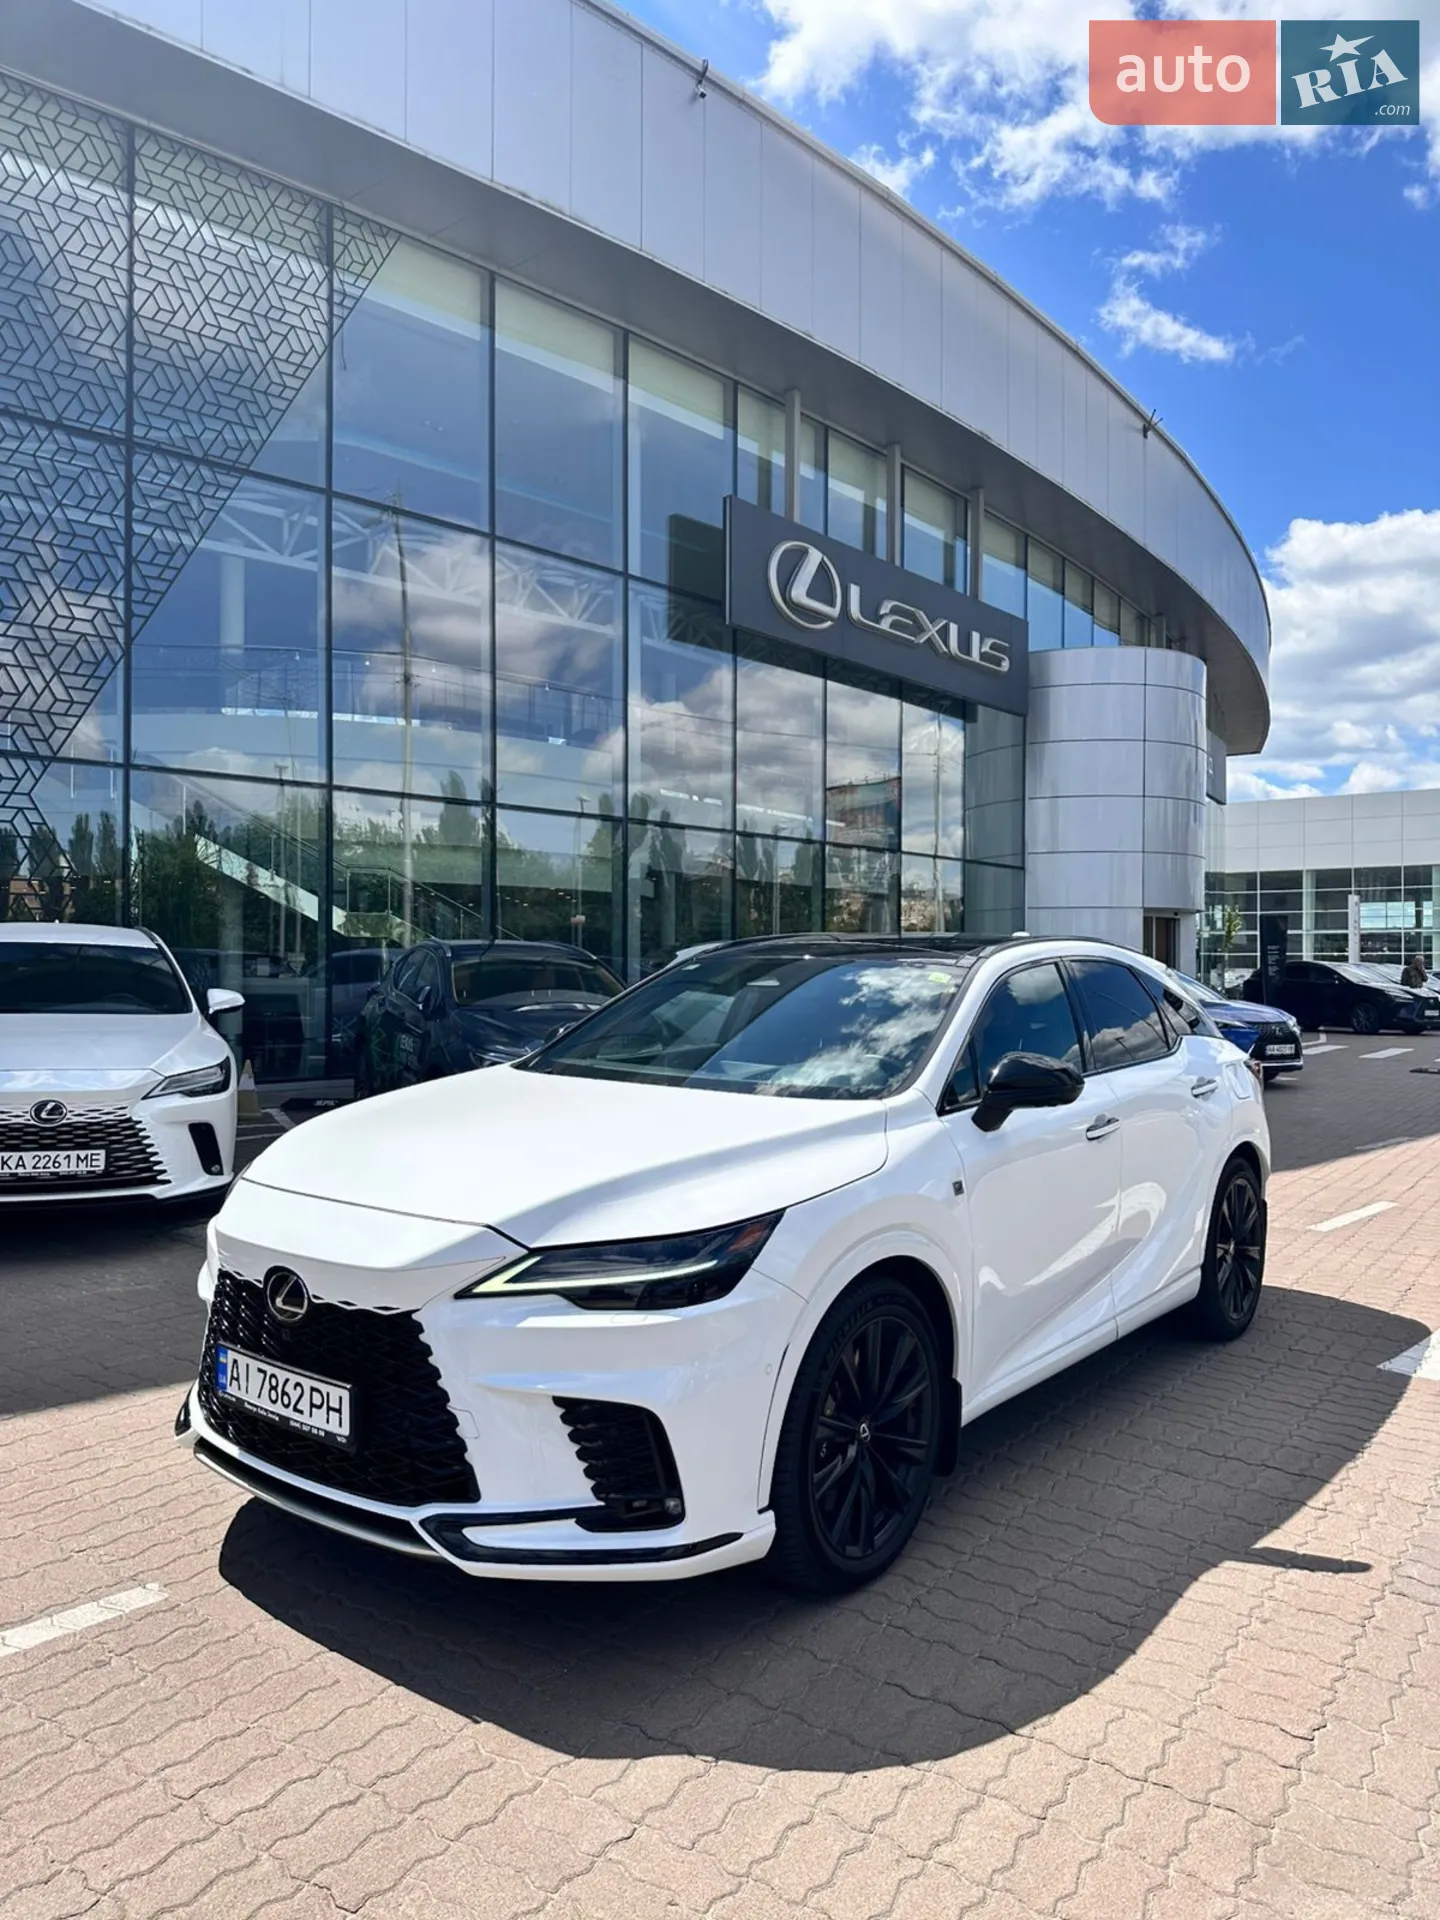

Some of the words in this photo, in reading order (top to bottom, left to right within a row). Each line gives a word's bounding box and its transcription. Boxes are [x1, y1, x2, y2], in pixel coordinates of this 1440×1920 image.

[847, 582, 1011, 674] LEXUS
[0, 1155, 27, 1171] KA
[31, 1153, 71, 1170] 2261
[76, 1152, 101, 1169] ME
[228, 1358, 249, 1395] AI
[256, 1366, 305, 1416] 7862
[309, 1385, 343, 1429] PH
